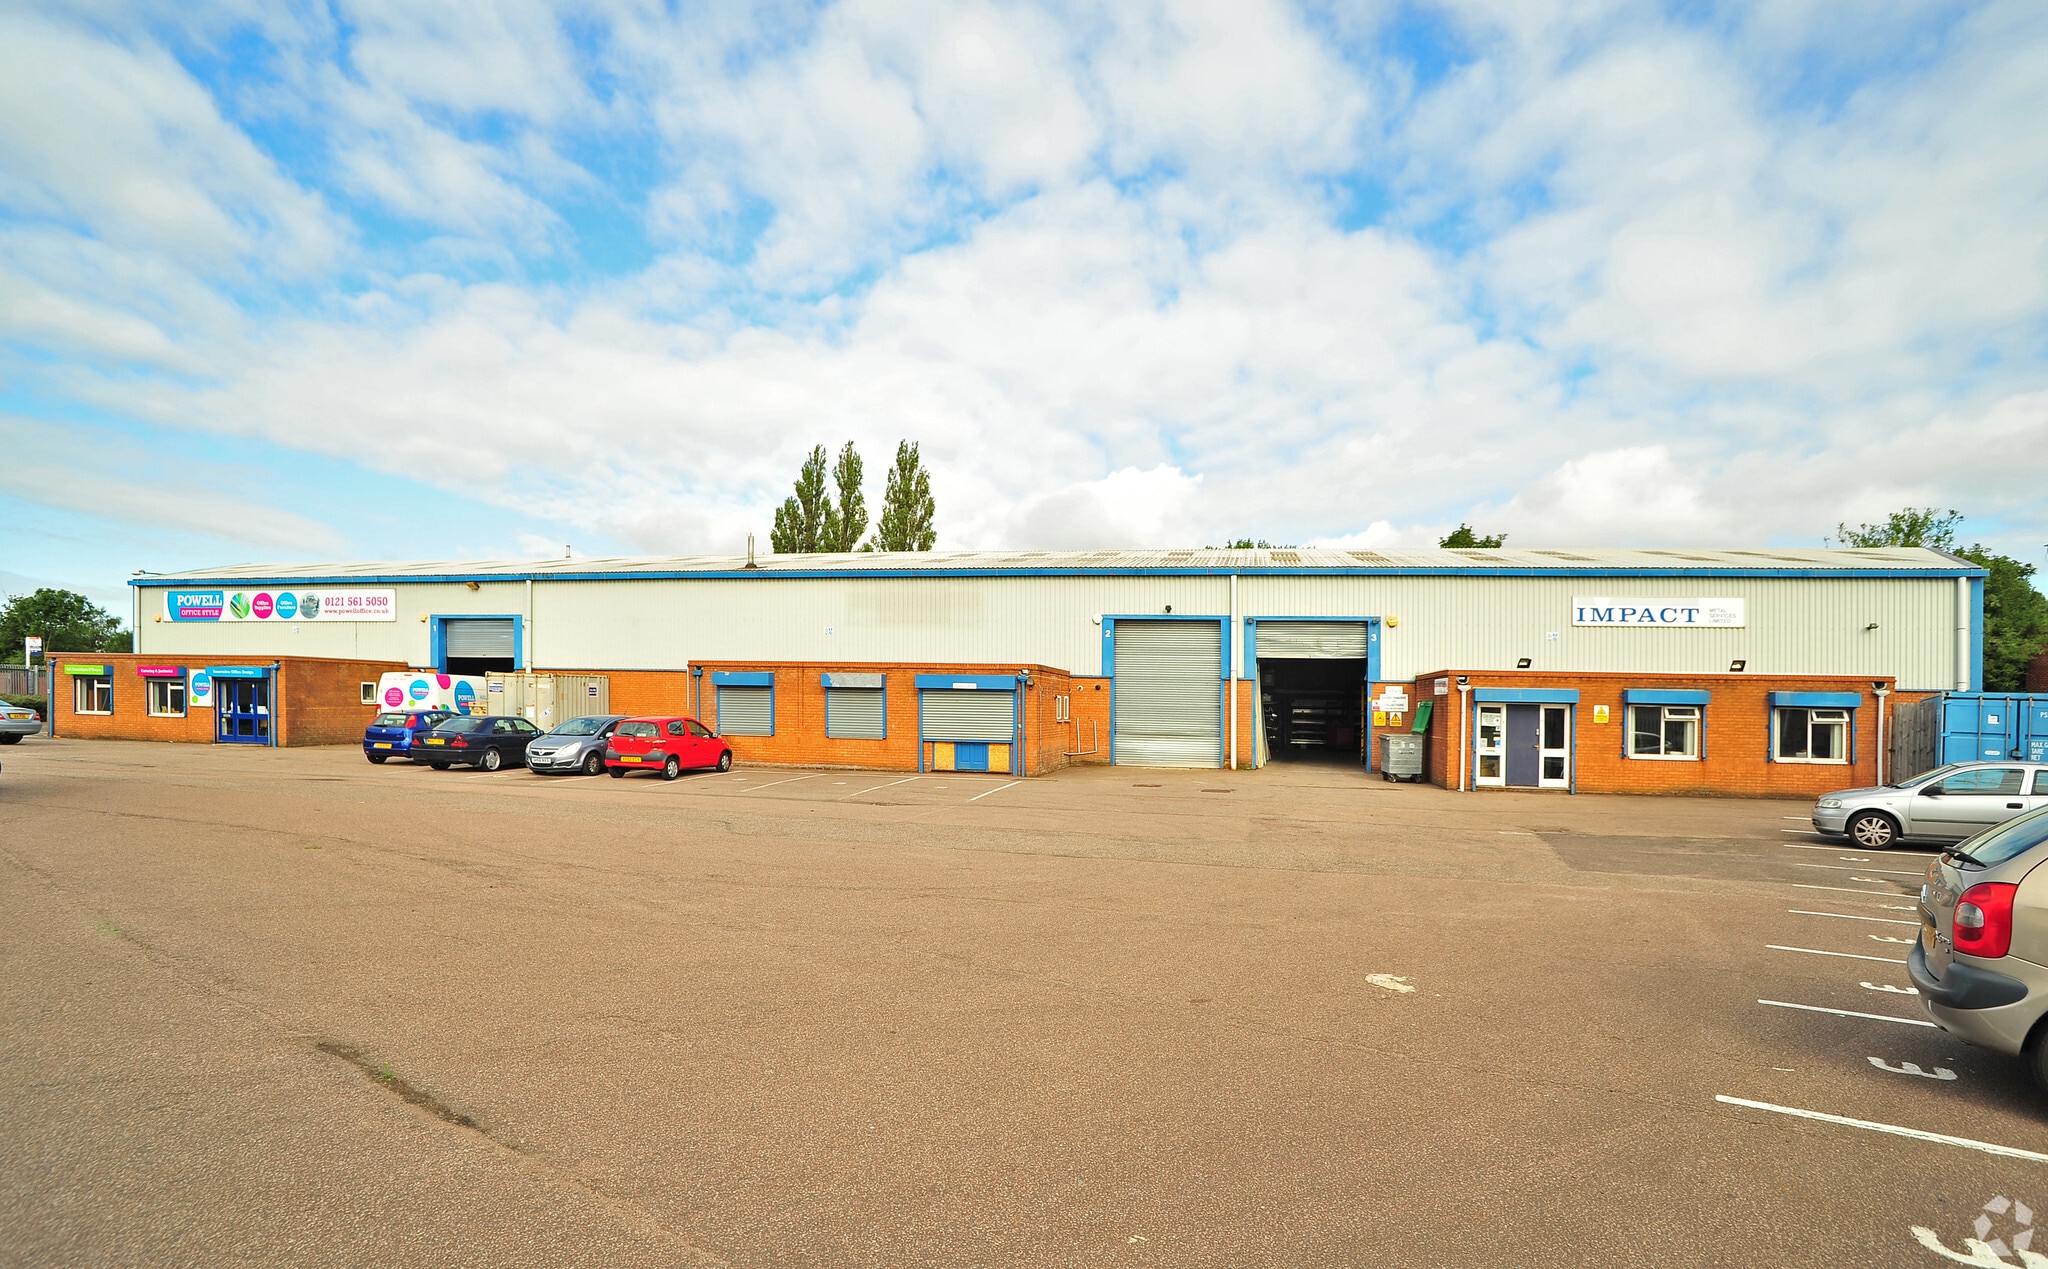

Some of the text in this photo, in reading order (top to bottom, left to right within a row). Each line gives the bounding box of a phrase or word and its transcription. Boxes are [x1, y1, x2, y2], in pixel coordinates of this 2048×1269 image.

[177, 594, 222, 606] POWELL
[325, 597, 388, 606] 0121 561 5050
[1576, 607, 1700, 623] IMPACT
[1105, 629, 1111, 638] 2
[1370, 633, 1377, 642] 3
